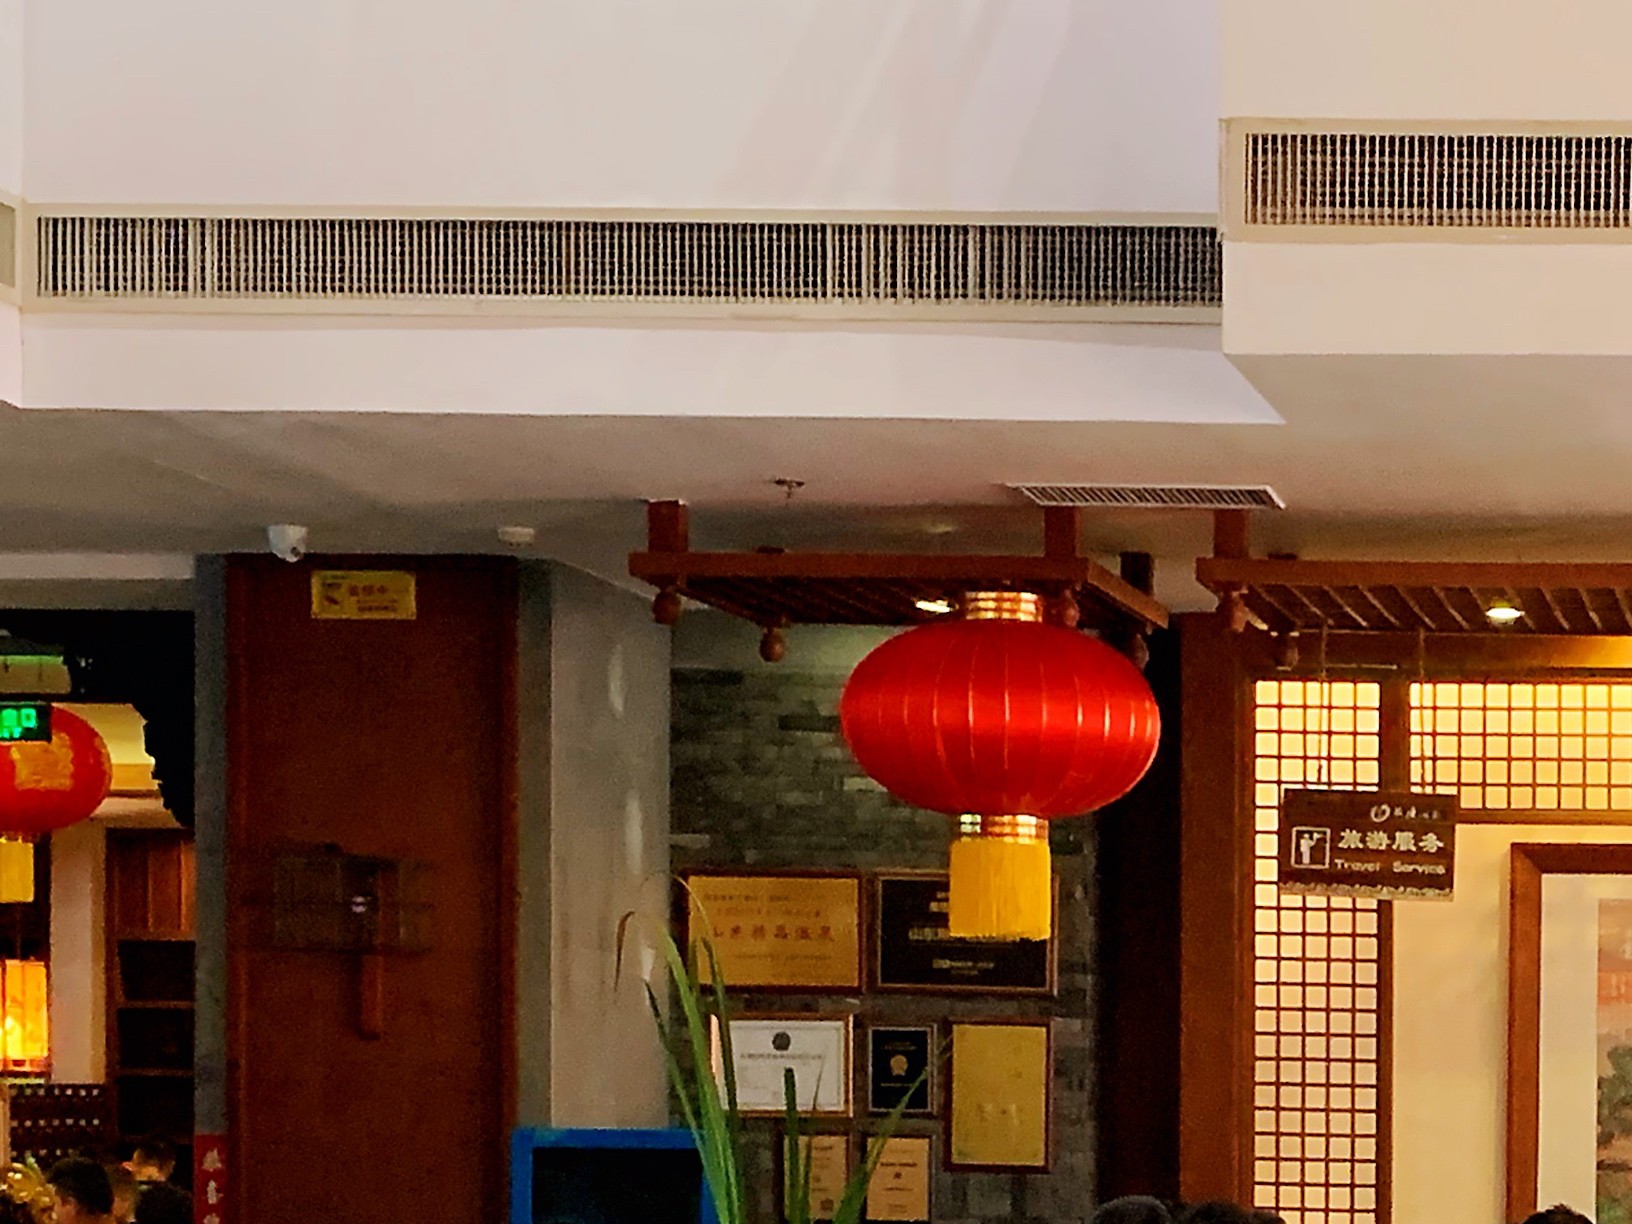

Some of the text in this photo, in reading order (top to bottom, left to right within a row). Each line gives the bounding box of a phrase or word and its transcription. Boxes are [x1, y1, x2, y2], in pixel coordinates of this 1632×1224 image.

[1338, 828, 1444, 853] 旅游服务
[1334, 858, 1446, 875] Travel Service
